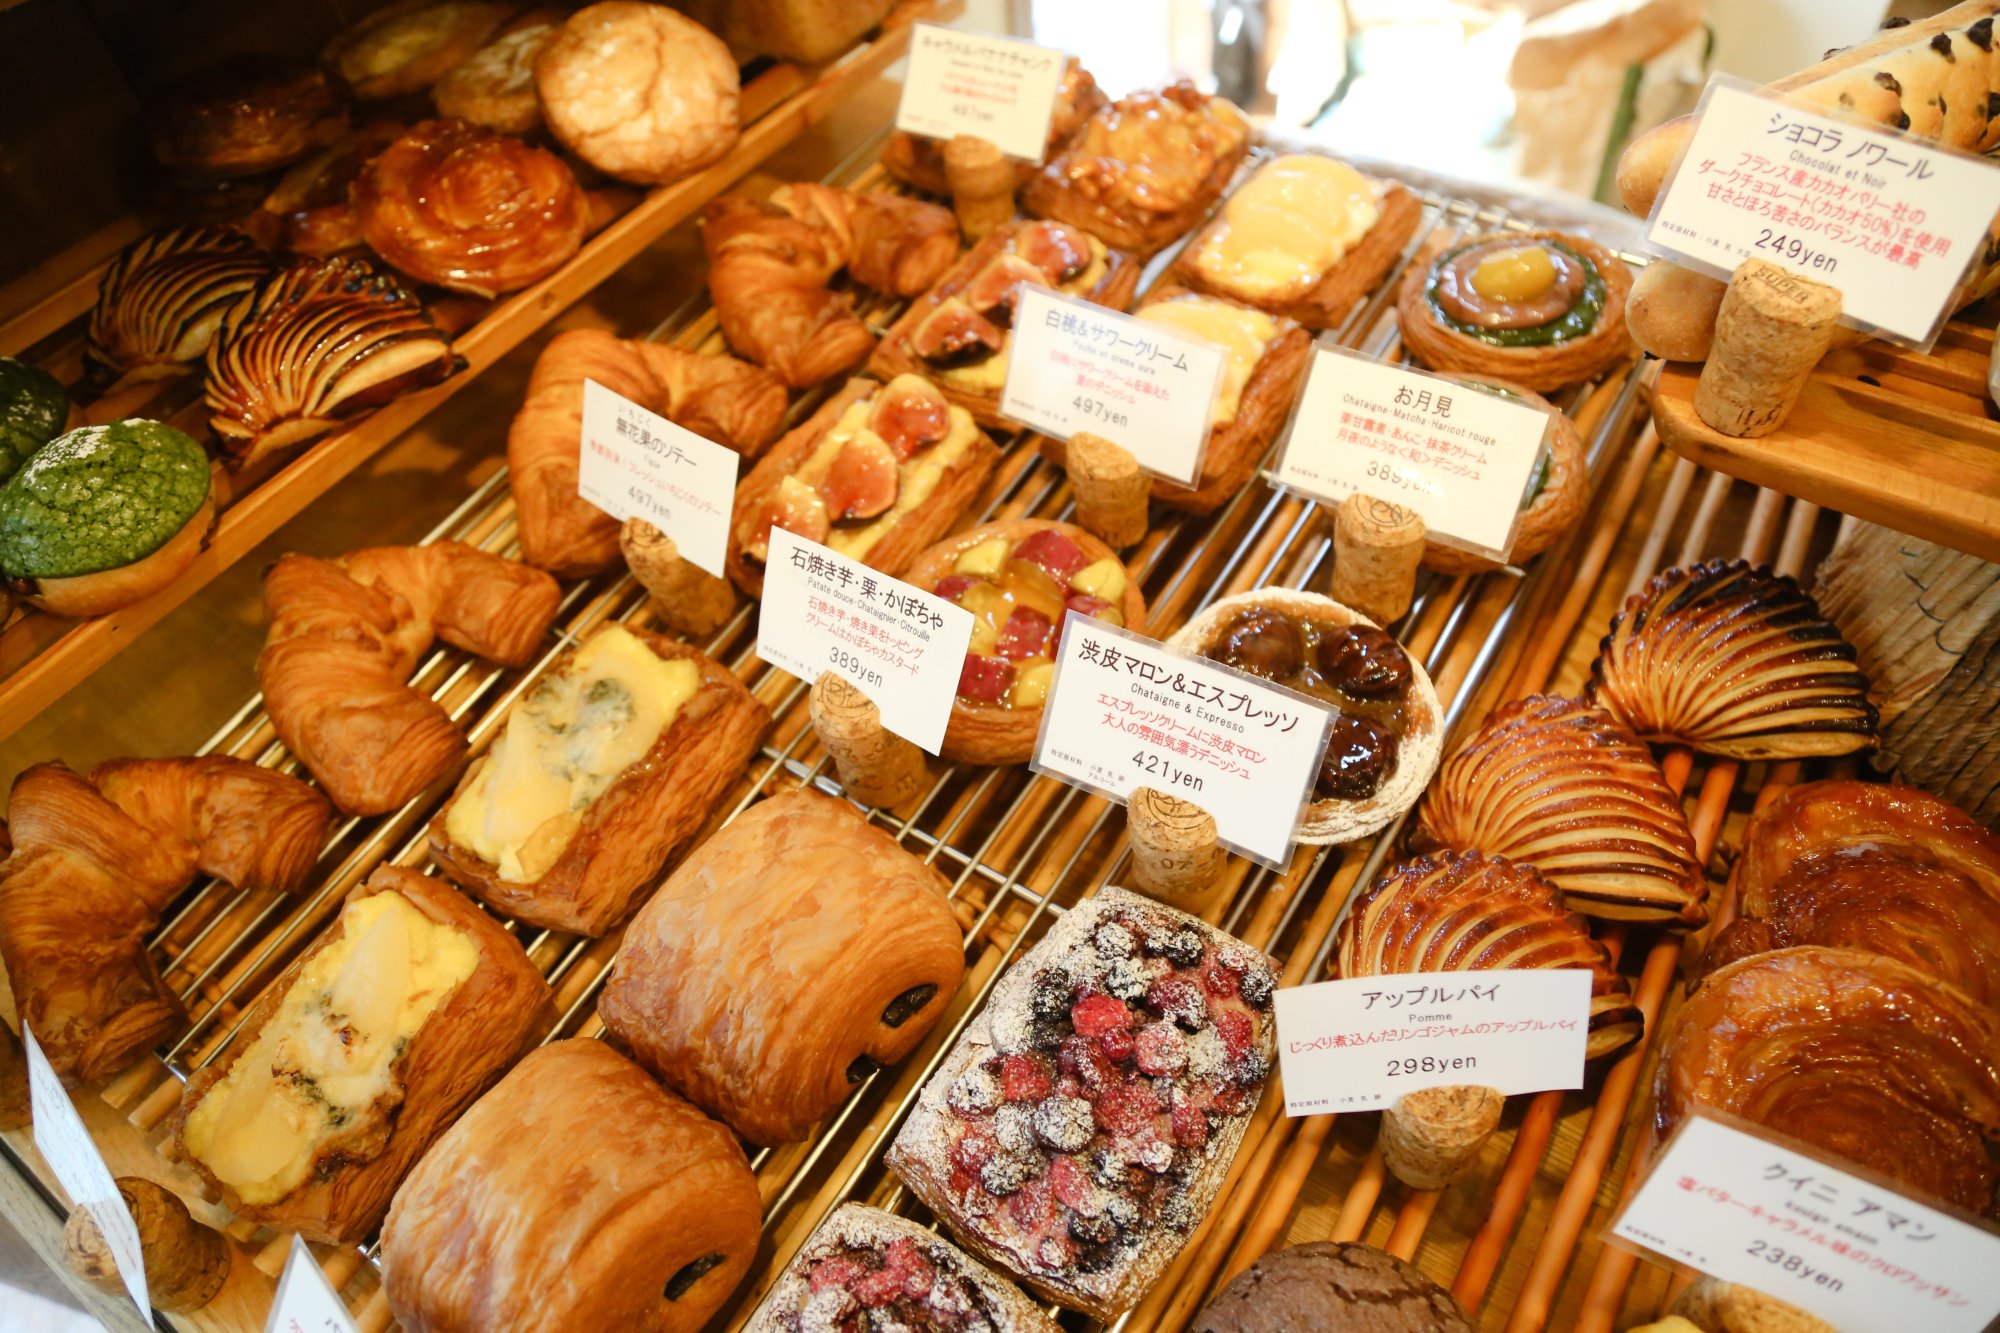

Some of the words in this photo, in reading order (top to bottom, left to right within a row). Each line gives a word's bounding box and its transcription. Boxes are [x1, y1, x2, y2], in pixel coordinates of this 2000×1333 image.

[1767, 112, 1843, 152] ショコラ
[1847, 141, 1935, 180] ノワール
[1789, 149, 1841, 176] Chocolat
[1845, 169, 1859, 181] et
[1861, 171, 1887, 189] Noir
[1707, 182, 1923, 270] 甘さとほろ苦さのバランスが最高
[1755, 228, 1838, 273] 249yen
[1752, 265, 1810, 302] SUPER
[1046, 308, 1189, 373] 白桃&サワークリーム
[1073, 395, 1129, 428] 497yen
[1394, 384, 1453, 418] お月見
[1469, 429, 1497, 447] rouge
[627, 486, 672, 519] 497yen
[790, 546, 944, 630] 石焼き芋・栗・かぼちゃ
[807, 576, 832, 595] Patate
[806, 612, 920, 676] クリームはかぼちゃカスタード
[808, 595, 925, 659] 石焼き芋・焼き栗をトッピング
[828, 646, 883, 688] 389yen
[1078, 637, 1300, 733] 渋皮マロン&エスプレッソ
[1097, 693, 1267, 765] エスプレッソクリームに渋皮マロン
[1130, 682, 1181, 710] Chataigne
[1185, 703, 1192, 714] &
[1196, 707, 1245, 734] Expresso
[1101, 713, 1251, 780] 大人の雰囲気漂うデニッシュ
[1132, 751, 1204, 792] 421yen
[1362, 984, 1502, 1010] アップルパイ
[1408, 1012, 1453, 1023] Pomme
[1288, 1019, 1579, 1055] じっくり煮込んだリンゴジャムのアップルパイ
[1386, 1055, 1478, 1078] 298yen
[1747, 1239, 1844, 1293] 238yen
